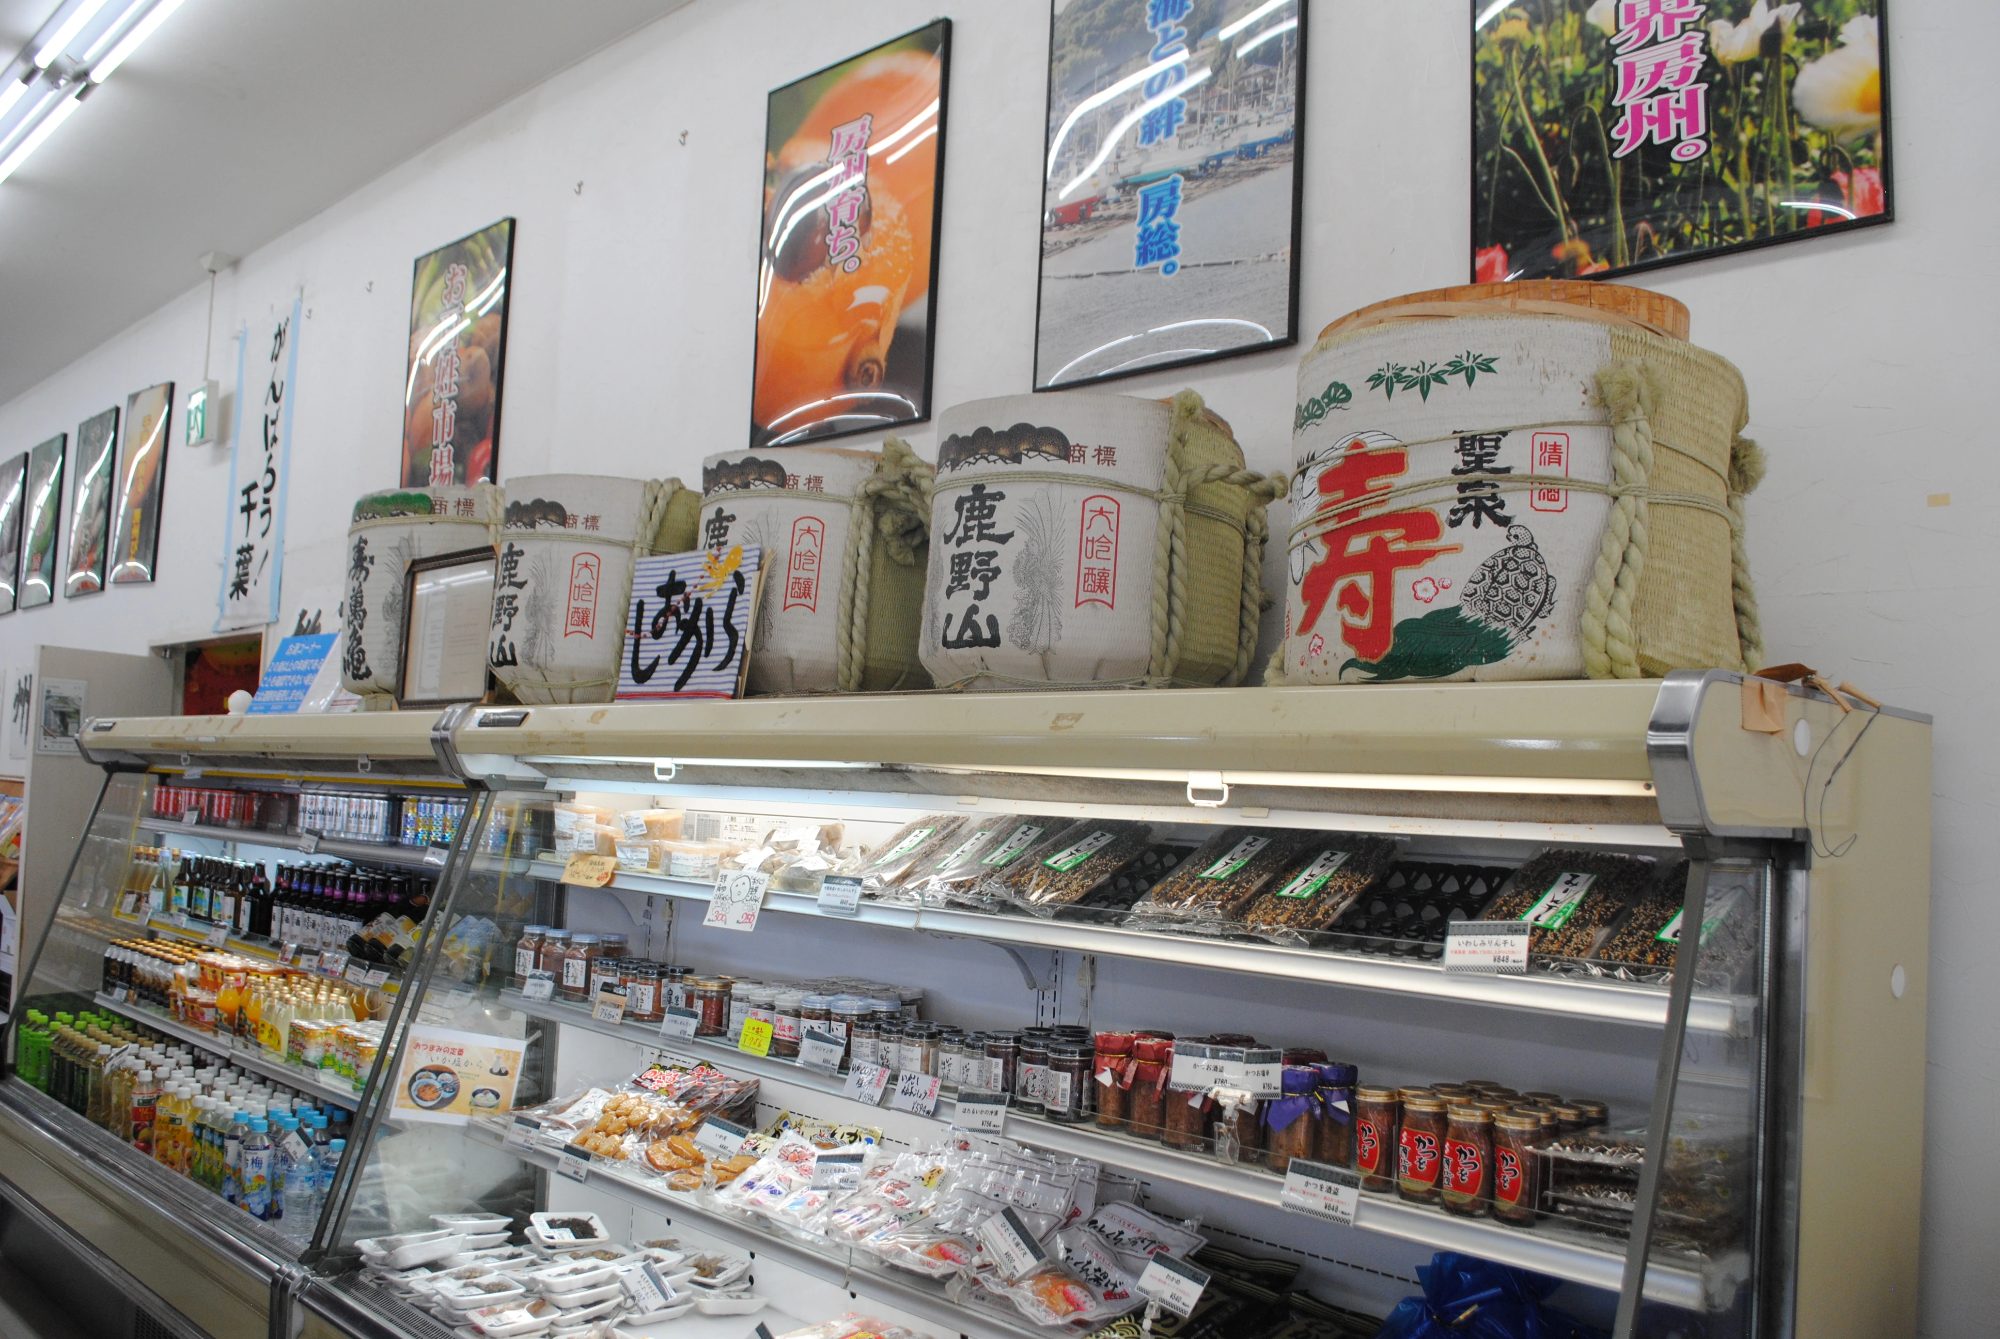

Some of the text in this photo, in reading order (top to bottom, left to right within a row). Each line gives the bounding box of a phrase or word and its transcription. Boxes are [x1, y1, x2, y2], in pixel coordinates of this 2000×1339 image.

[1134, 174, 1184, 277] 房総。
[1069, 444, 1117, 467] 商標
[786, 474, 824, 491] 商標
[230, 481, 259, 600] 千葉
[564, 513, 601, 531] 商標
[942, 484, 1015, 649] 鹿野山
[1296, 438, 1463, 663] 寿
[490, 542, 528, 669] 鹿野山
[413, 1042, 465, 1056] おつまみの定番
[1360, 1124, 1376, 1158] かつを
[1414, 1135, 1438, 1171] かつを
[1456, 1145, 1479, 1183] かつを
[1499, 1152, 1520, 1189] かつを
